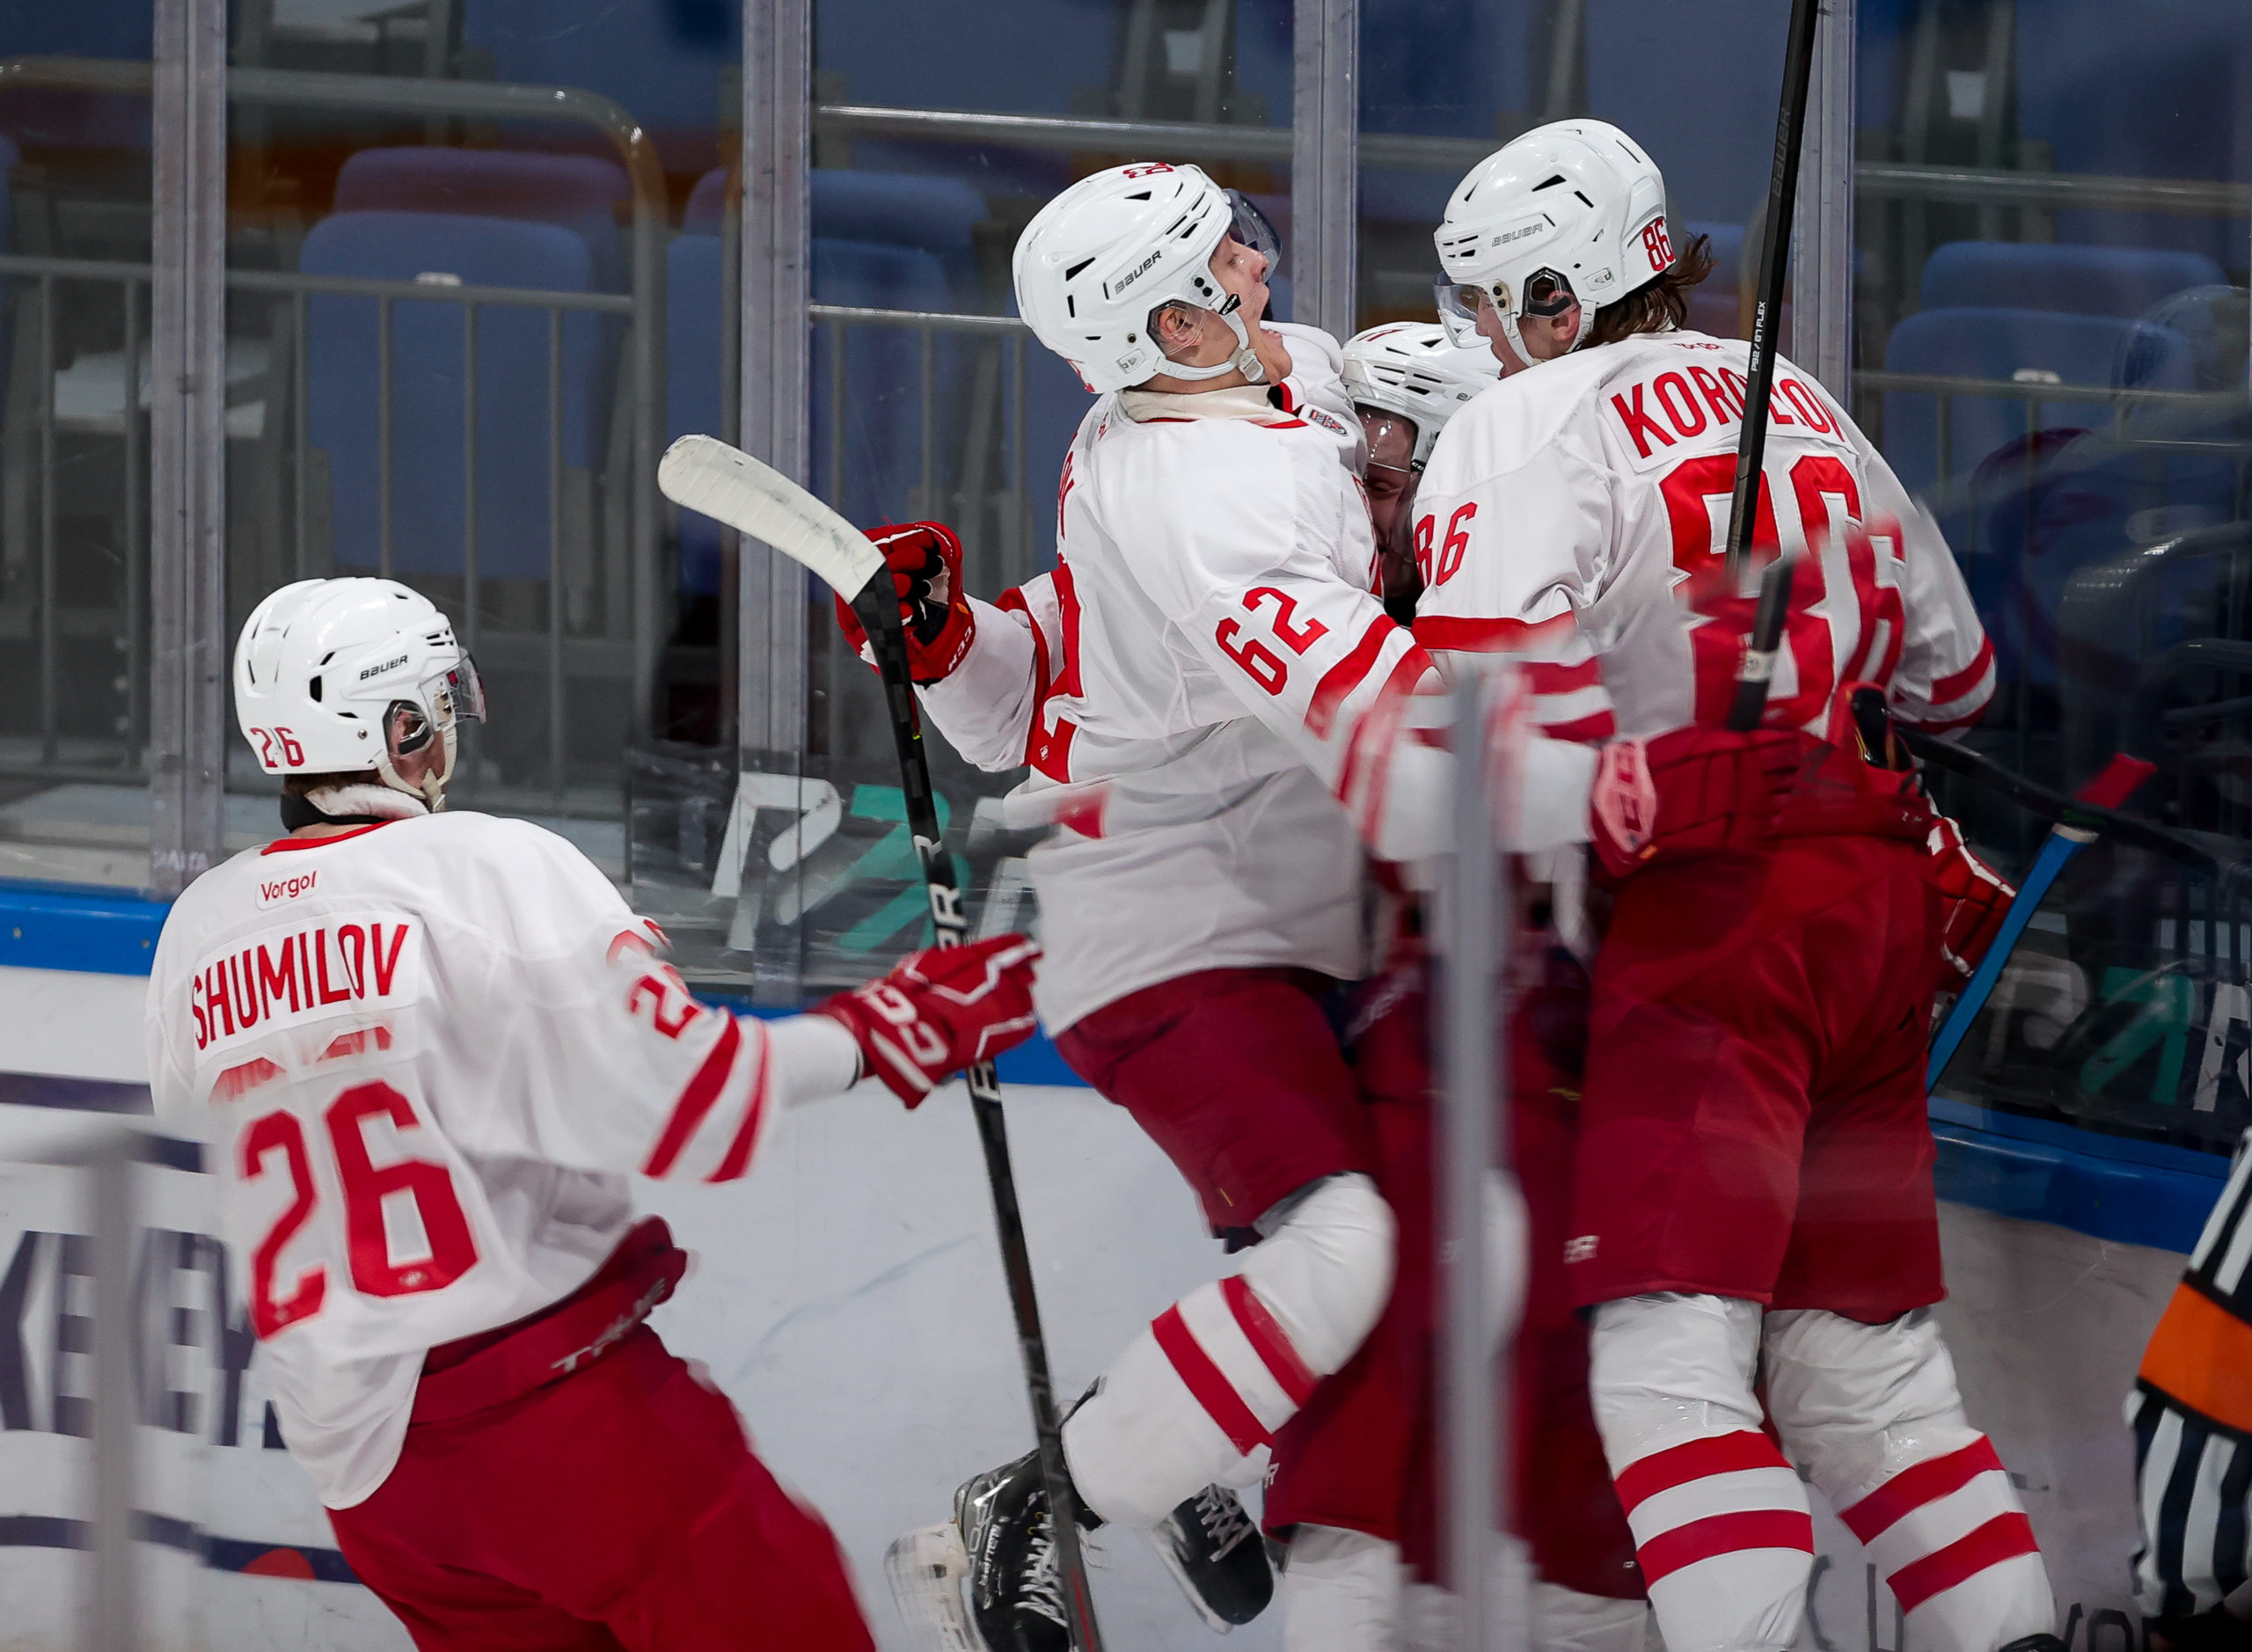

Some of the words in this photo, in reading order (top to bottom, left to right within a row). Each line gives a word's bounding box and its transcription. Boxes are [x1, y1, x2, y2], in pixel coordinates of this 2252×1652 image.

[1491, 223, 1543, 248] BAUER
[1641, 216, 1676, 272] 86
[1115, 250, 1162, 295] BAUER
[1756, 301, 1766, 328] FLEX
[1414, 501, 1479, 590] 86
[1658, 450, 1906, 730] 86
[1215, 586, 1331, 697] 62
[359, 654, 409, 681] BAUER
[249, 727, 305, 768] 26
[260, 870, 318, 903] Vorgol
[192, 922, 410, 1051] SHUMILOV
[230, 1075, 482, 1343] 26
